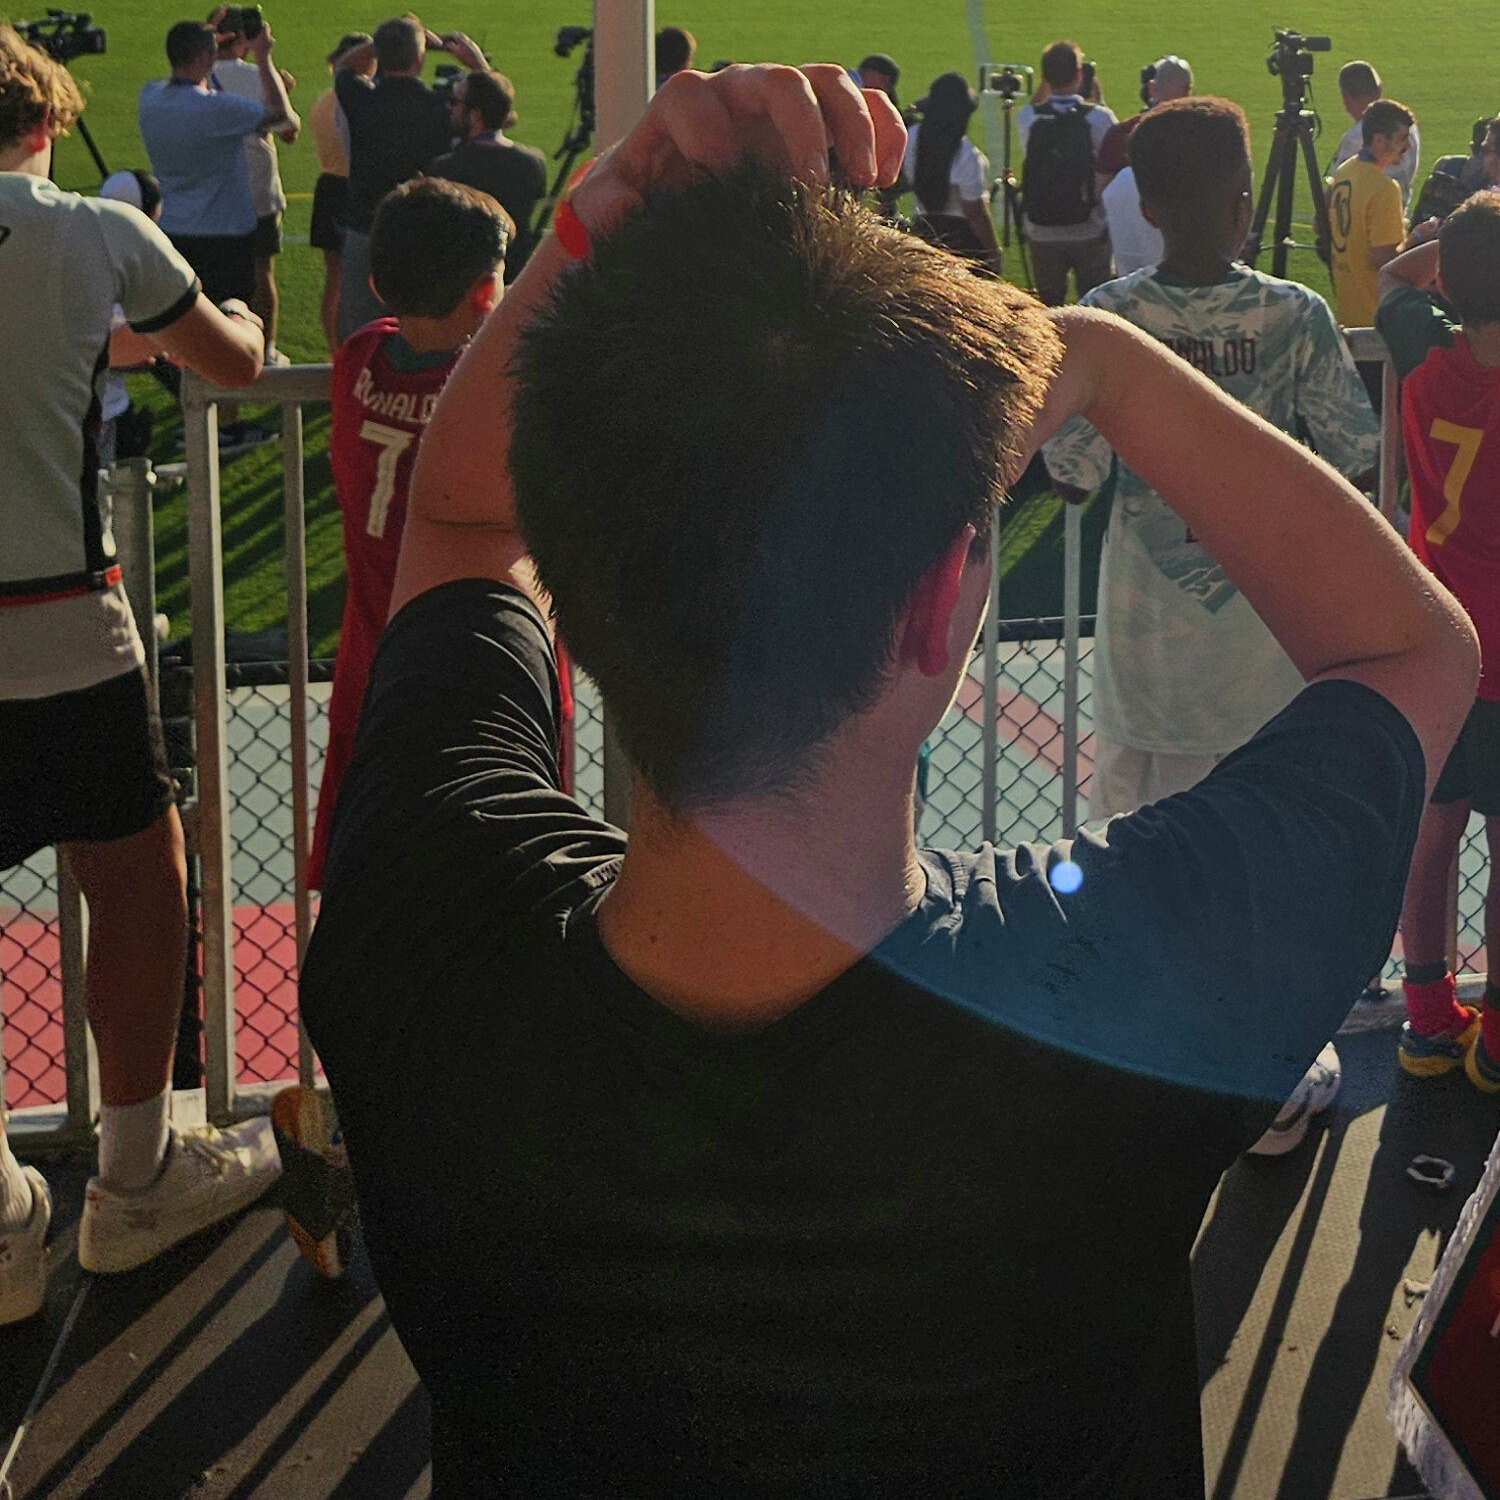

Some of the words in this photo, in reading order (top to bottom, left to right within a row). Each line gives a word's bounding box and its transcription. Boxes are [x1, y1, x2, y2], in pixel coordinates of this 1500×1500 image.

[1160, 336, 1256, 377] NALDO
[359, 419, 416, 539] 7
[1425, 418, 1486, 546] 7
